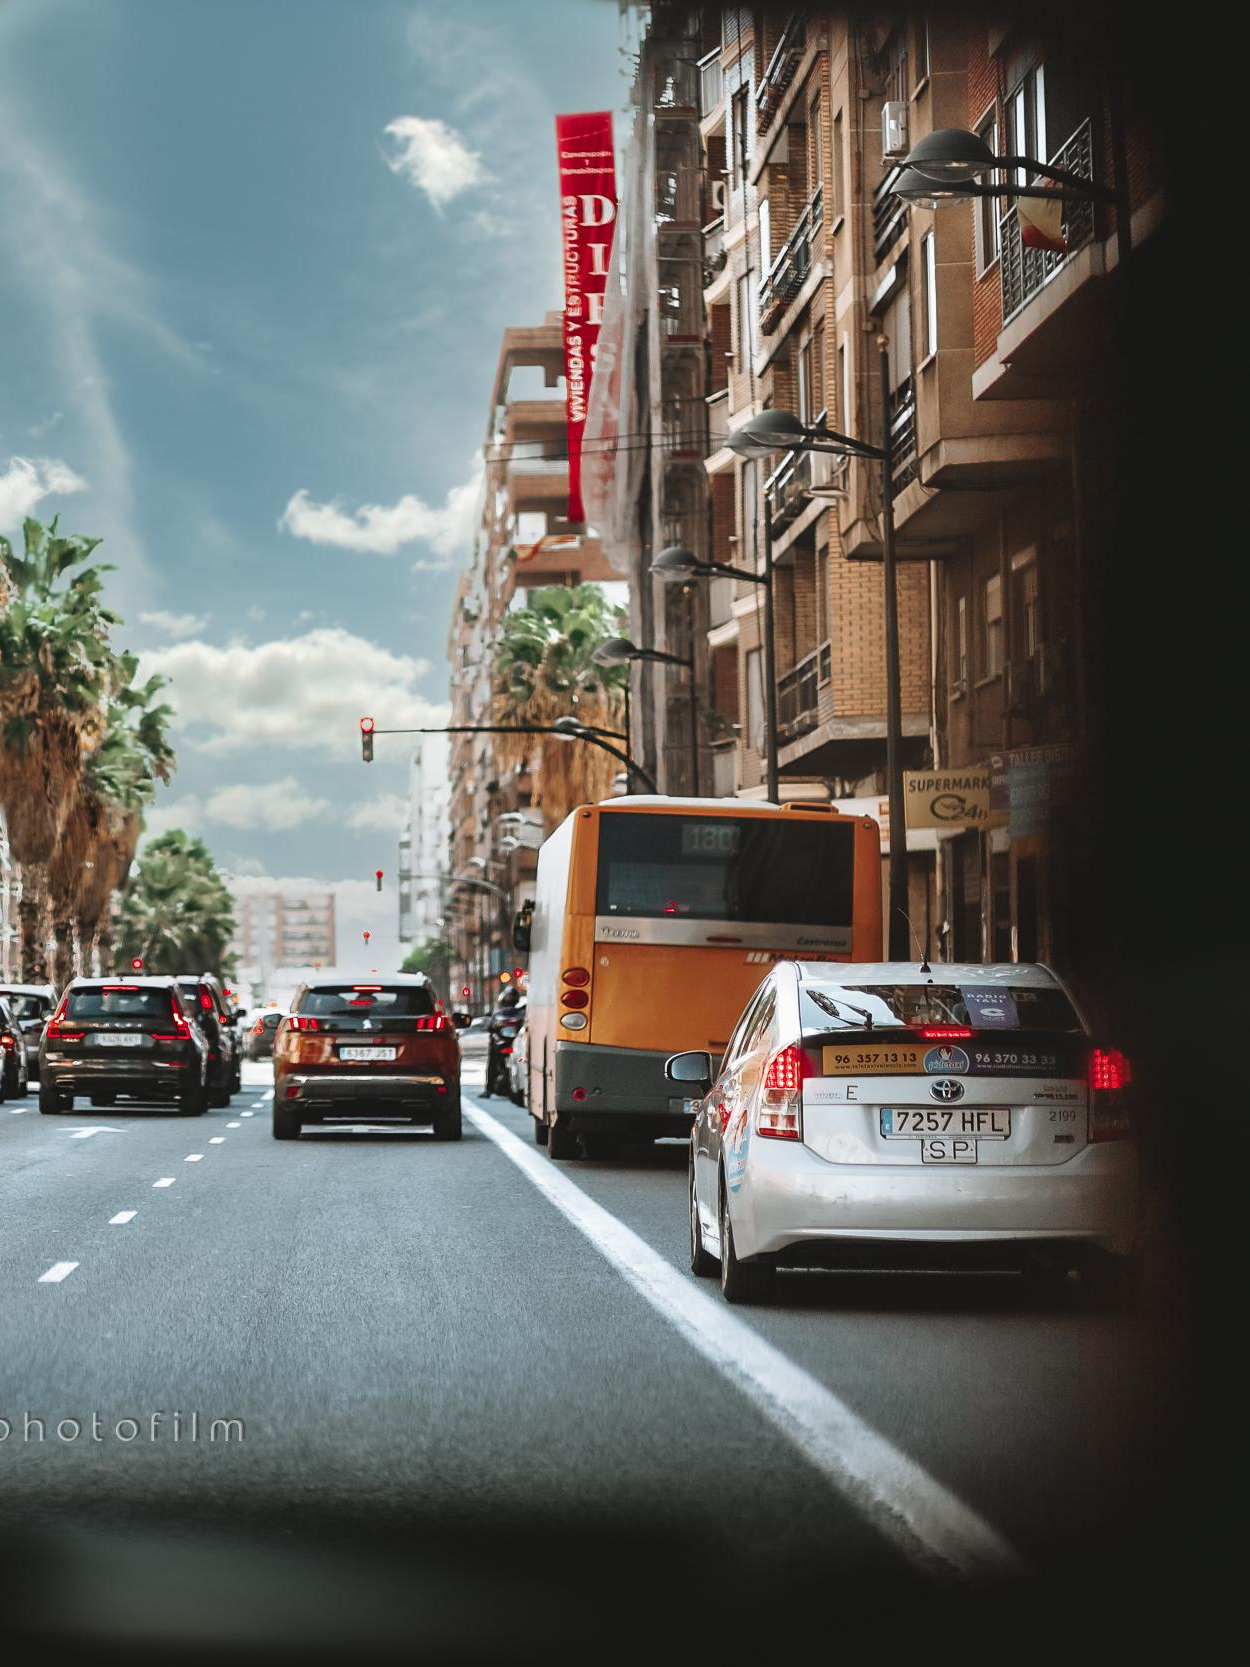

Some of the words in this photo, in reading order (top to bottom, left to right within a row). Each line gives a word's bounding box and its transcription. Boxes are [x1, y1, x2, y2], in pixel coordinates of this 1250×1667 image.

[563, 195, 582, 317] ESTRUCTURAS
[567, 321, 582, 332] Y
[567, 334, 586, 422] VIVIENDAS
[908, 776, 990, 793] SUPERMARK
[834, 1054, 850, 1064] 96
[857, 1053, 880, 1063] 357
[884, 1053, 898, 1062] 13
[902, 1052, 917, 1062] 13
[975, 1053, 991, 1063] 96
[995, 1053, 1018, 1064] 370
[1021, 1054, 1037, 1064] 33
[846, 1085, 858, 1100] E
[897, 1112, 953, 1132] 7257
[961, 1112, 1004, 1132] HFL
[1049, 1110, 1077, 1121] 2199
